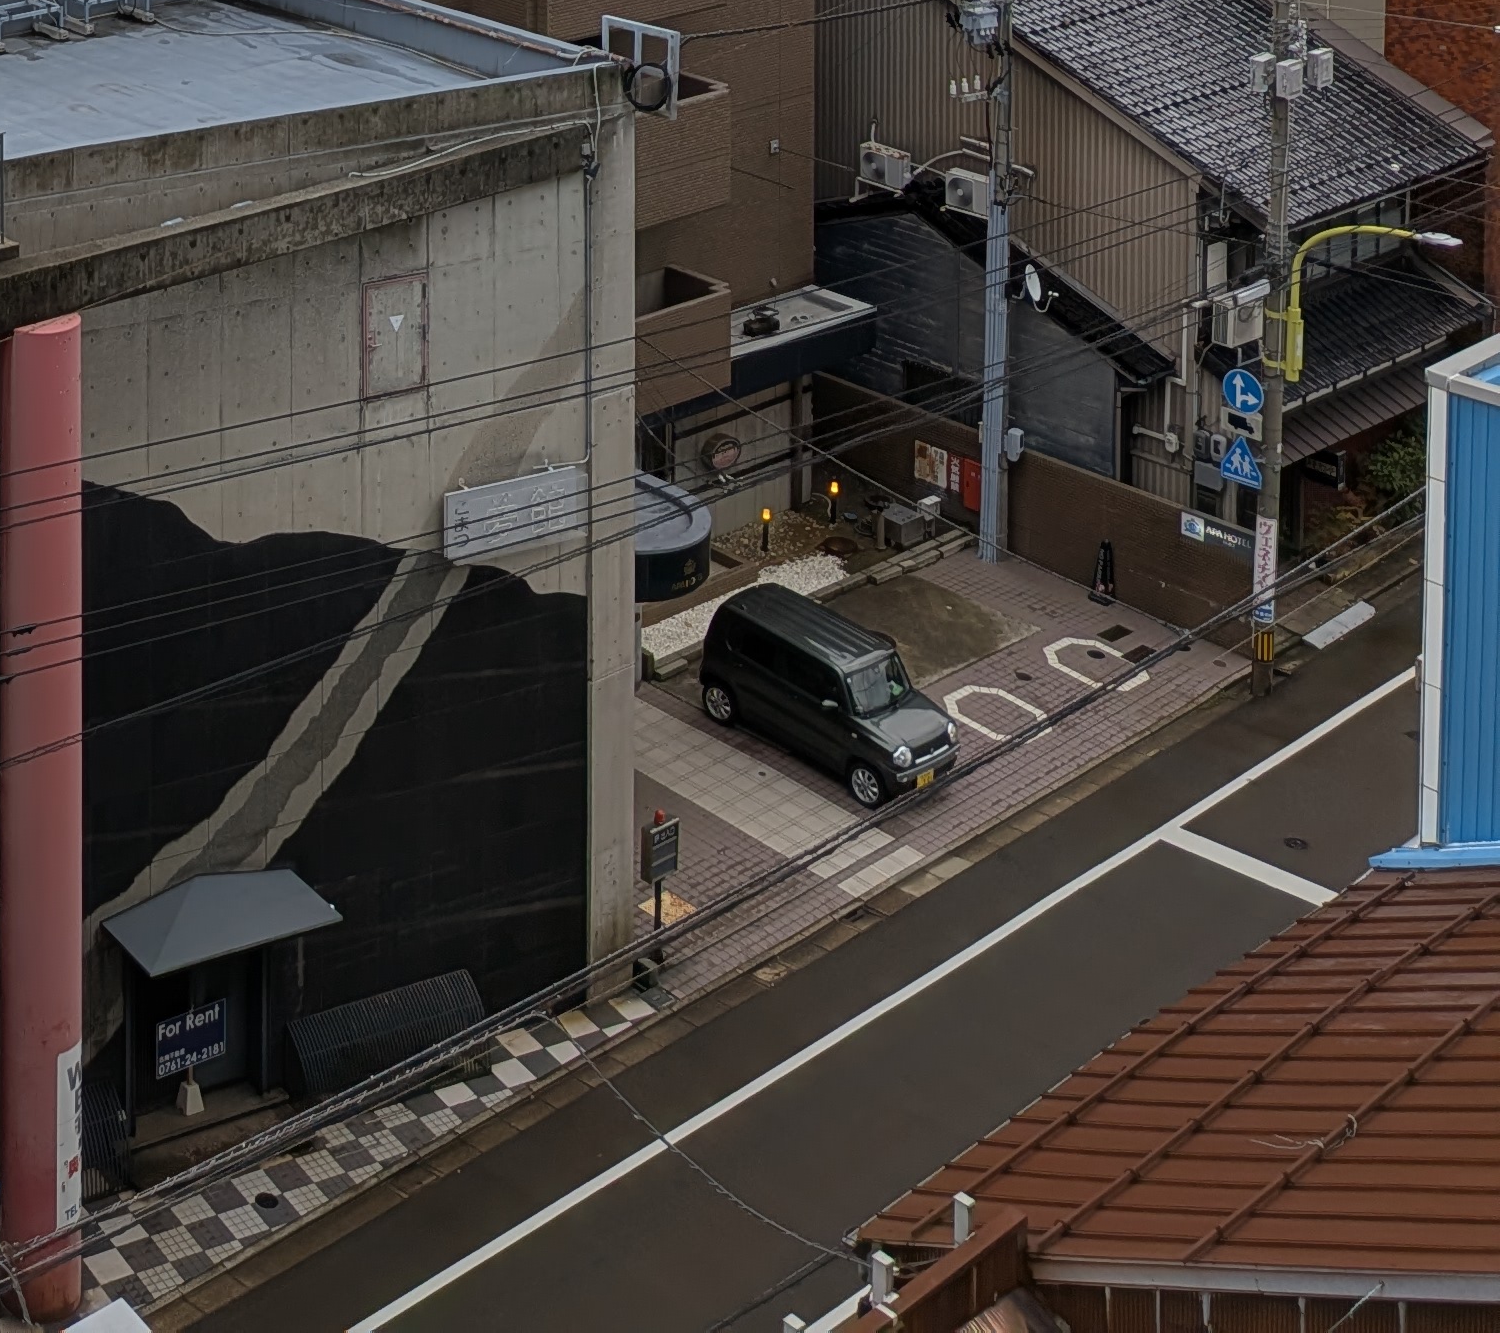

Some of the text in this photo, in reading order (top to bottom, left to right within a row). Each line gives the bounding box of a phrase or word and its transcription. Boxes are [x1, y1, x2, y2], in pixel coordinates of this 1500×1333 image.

[1223, 531, 1252, 549] HOTEL
[158, 1003, 220, 1041] For Rent
[158, 1041, 224, 1075] 0761-24-2181
[64, 1203, 79, 1221] TEL
